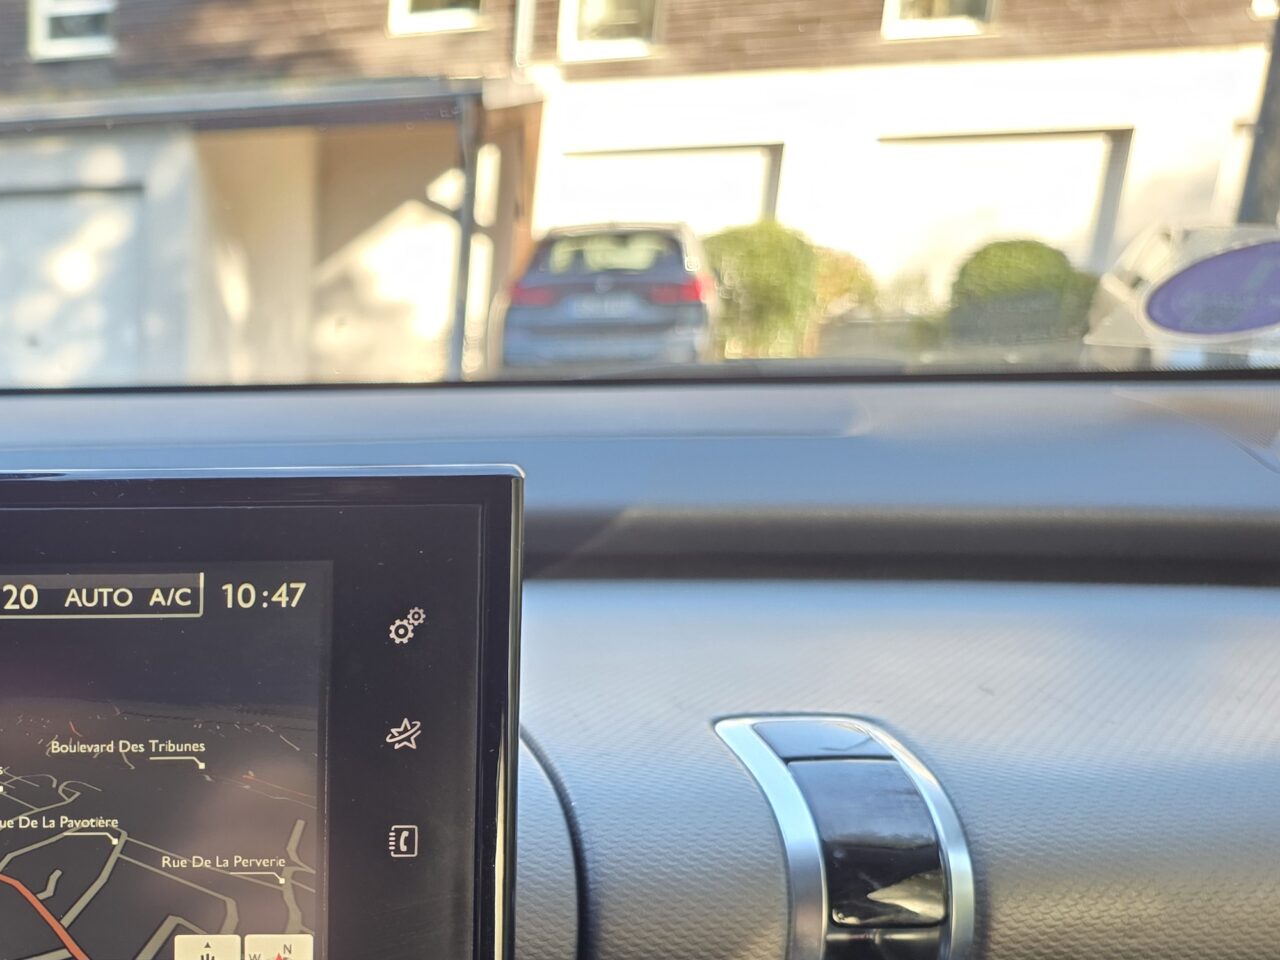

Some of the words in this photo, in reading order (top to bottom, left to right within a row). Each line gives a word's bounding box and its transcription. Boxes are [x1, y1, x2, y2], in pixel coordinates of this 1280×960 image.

[2, 584, 39, 610] 20
[64, 588, 133, 608] AUTO
[149, 587, 192, 608] A/C
[222, 582, 307, 609] 10:47
[50, 740, 115, 754] Boulevard
[118, 740, 145, 754] Des
[148, 740, 206, 753] Tribunes
[18, 816, 38, 829] De
[42, 816, 56, 829] La
[161, 856, 188, 868] Rue
[192, 856, 212, 868] De
[216, 856, 229, 868] La
[233, 855, 286, 867] Perverie
[283, 944, 292, 954] N
